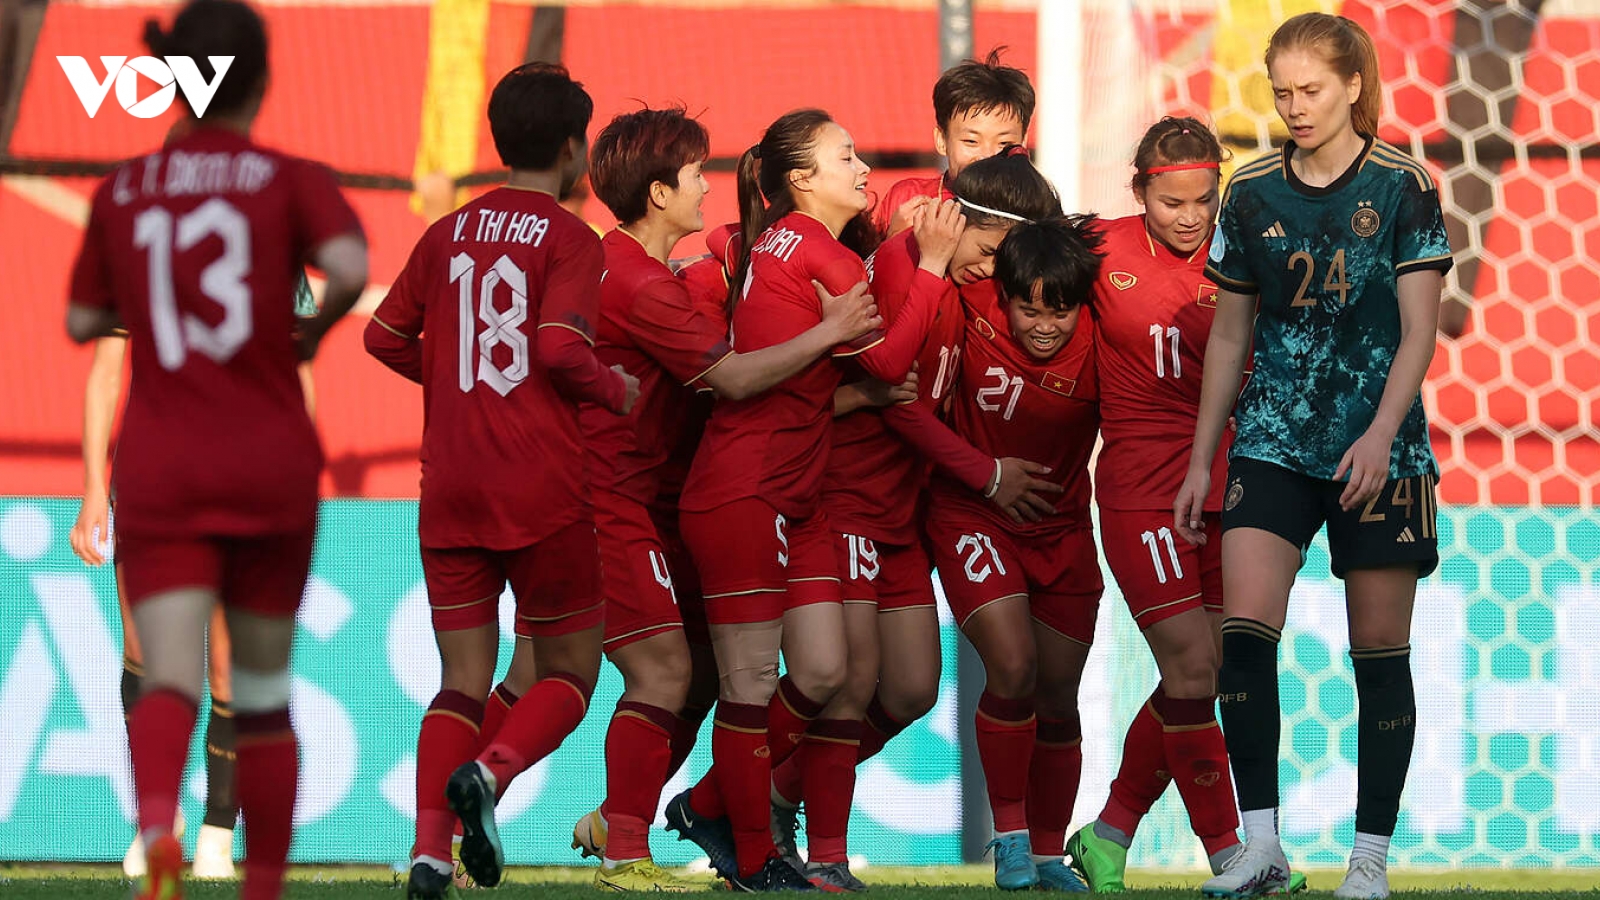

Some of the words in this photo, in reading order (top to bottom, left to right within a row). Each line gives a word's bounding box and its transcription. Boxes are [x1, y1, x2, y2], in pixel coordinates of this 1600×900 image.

[453, 211, 469, 242] V.
[475, 209, 508, 242] THI
[504, 211, 549, 247] HOA
[133, 197, 253, 371] 13
[1287, 249, 1352, 308] 24
[449, 251, 529, 397] 18
[1149, 323, 1182, 379] 11
[975, 366, 1025, 421] 21
[842, 533, 880, 580] 19
[955, 532, 1007, 583] 21
[1141, 526, 1184, 584] 11
[1378, 715, 1412, 730] DFB
